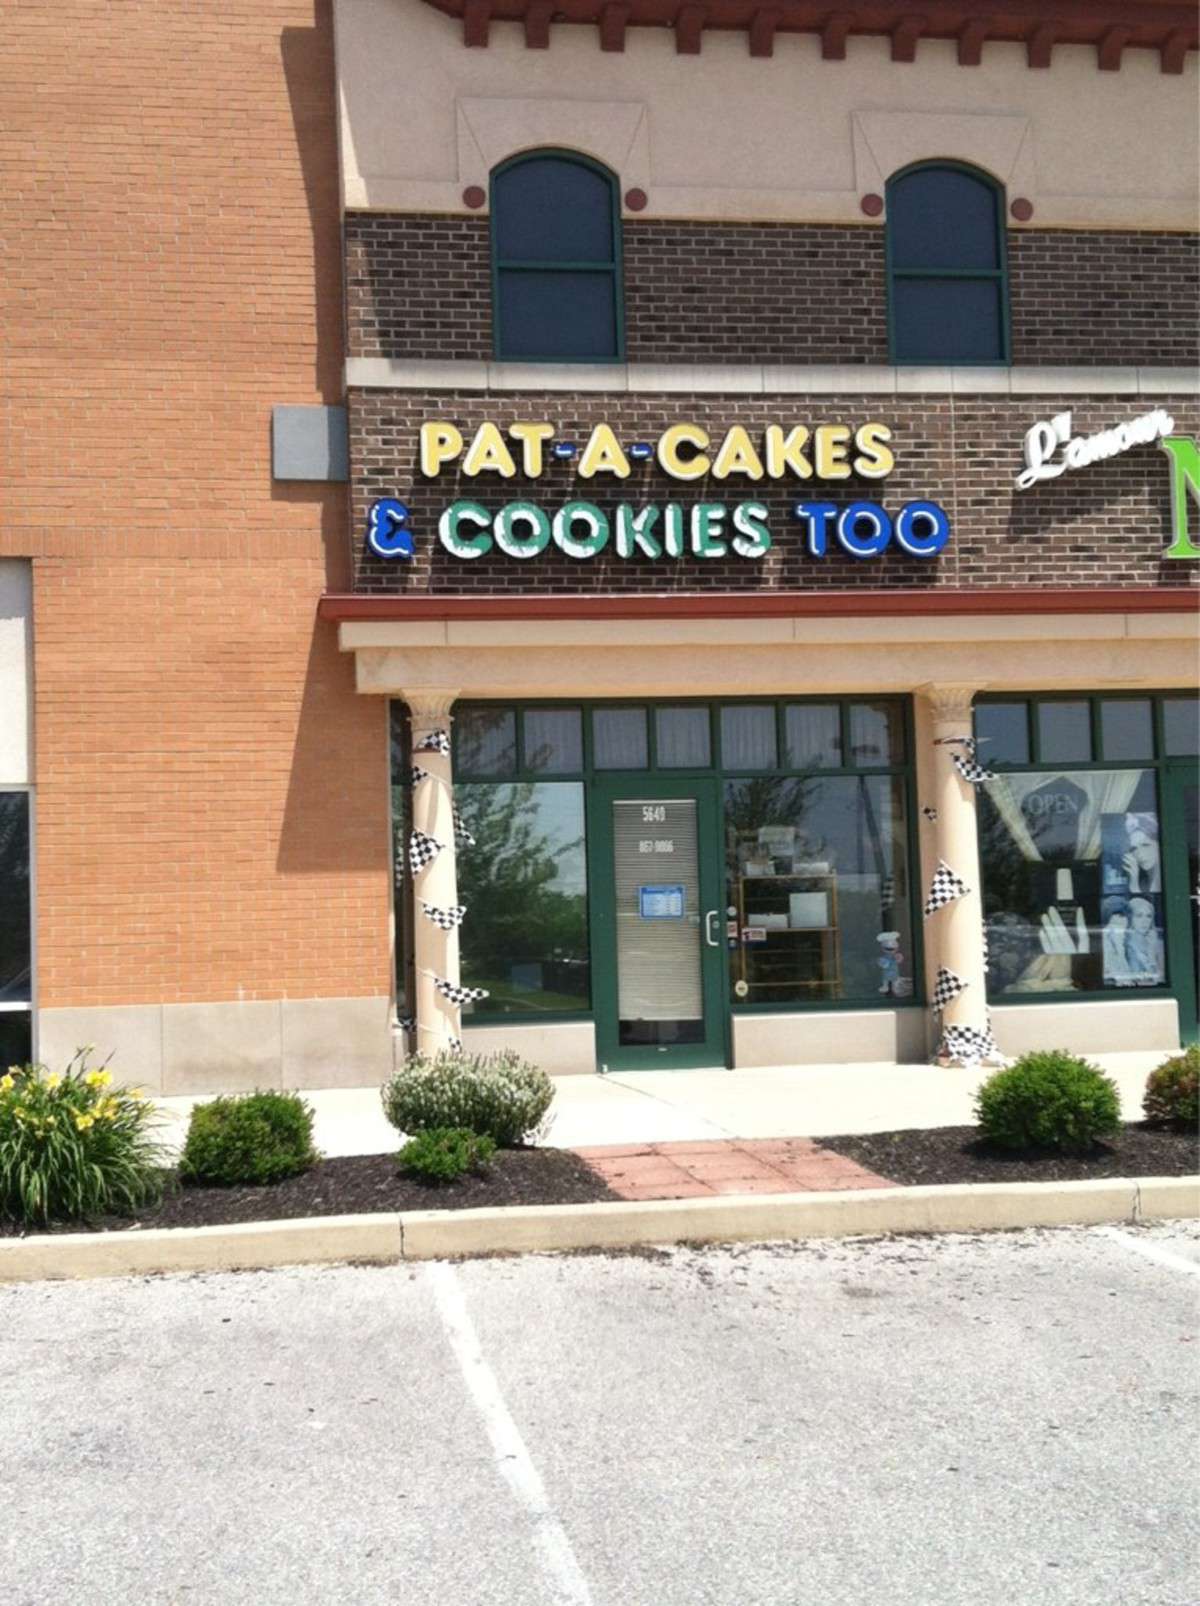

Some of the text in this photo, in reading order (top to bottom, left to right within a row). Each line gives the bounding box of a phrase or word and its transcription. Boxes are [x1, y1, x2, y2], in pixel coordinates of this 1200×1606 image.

[420, 421, 895, 481] PAT-A-CAKES
[367, 498, 951, 560] & COOKIES TOO
[1028, 791, 1079, 816] OPEN
